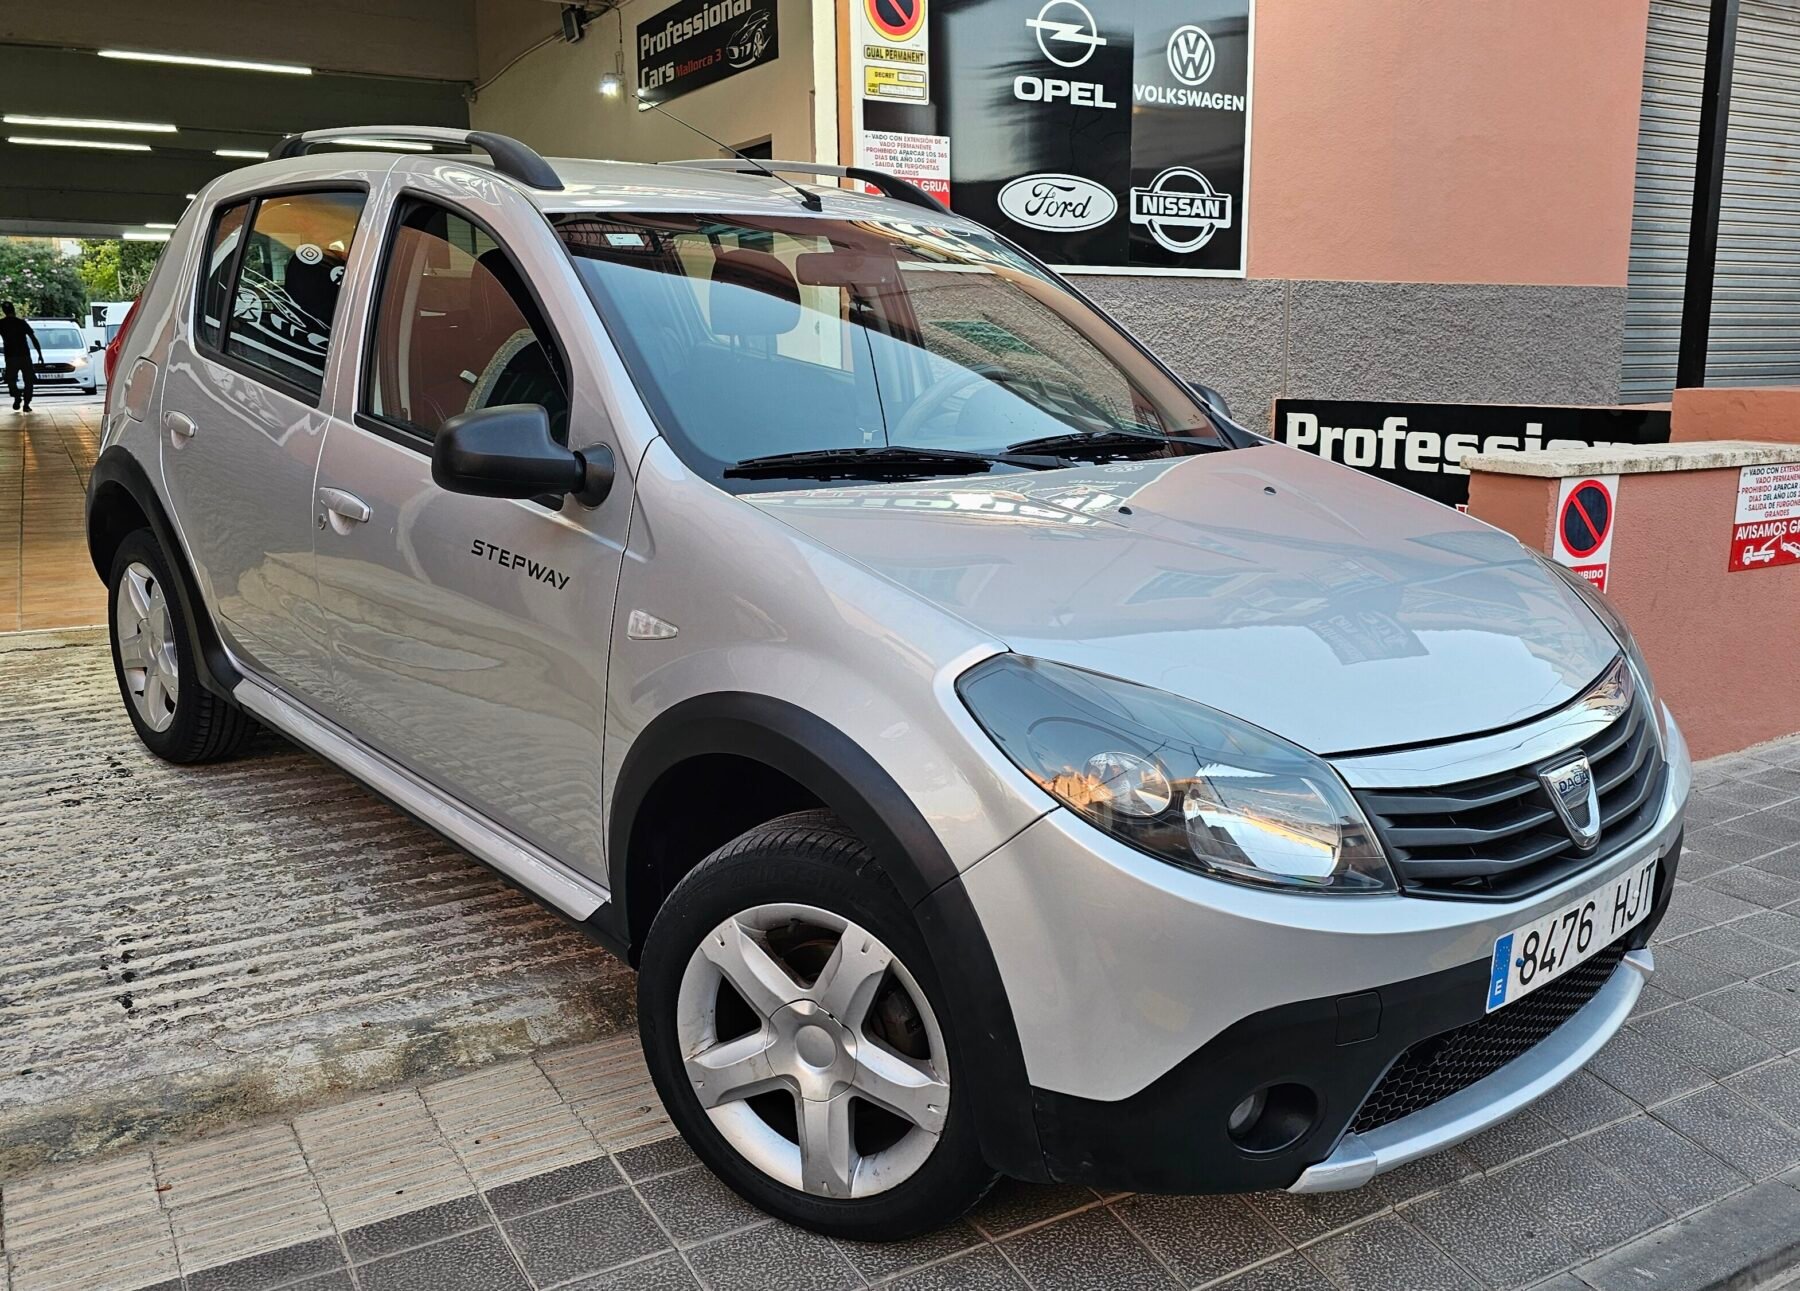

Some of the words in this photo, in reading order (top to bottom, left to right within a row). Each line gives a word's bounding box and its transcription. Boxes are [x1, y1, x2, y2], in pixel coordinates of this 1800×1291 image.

[885, 49, 924, 63] PERMANENT
[641, 62, 675, 91] Cars
[676, 55, 713, 78] Mallorca
[715, 48, 722, 62] 3
[1013, 75, 1117, 109] OPEL
[1133, 84, 1244, 111] VOLKSWAGEN
[866, 146, 897, 155] PROHIBIDO
[899, 149, 924, 157] APARCAR
[897, 143, 931, 151] PERMANENTE
[875, 160, 895, 168] SALIDA
[904, 162, 940, 171] FURGONETAS
[921, 180, 949, 193] GRUA
[1025, 182, 1092, 219] Ford
[1142, 195, 1219, 218] NISSAN
[1749, 467, 1765, 476] VADO
[1766, 466, 1779, 475] CON
[1756, 476, 1771, 484] VADO
[1741, 485, 1772, 495] PROHIBIDO
[1773, 482, 1799, 491] APARCAR
[1763, 493, 1772, 501] DEL
[1748, 503, 1767, 512] SALIDA
[1764, 509, 1790, 518] GRANDES
[1735, 521, 1787, 541] AVISAMOS
[471, 539, 570, 590] STEPWAY
[1559, 770, 1590, 793] DACIA
[1494, 979, 1504, 996] E
[1519, 900, 1596, 986] 8476
[1611, 859, 1656, 935] HJT
